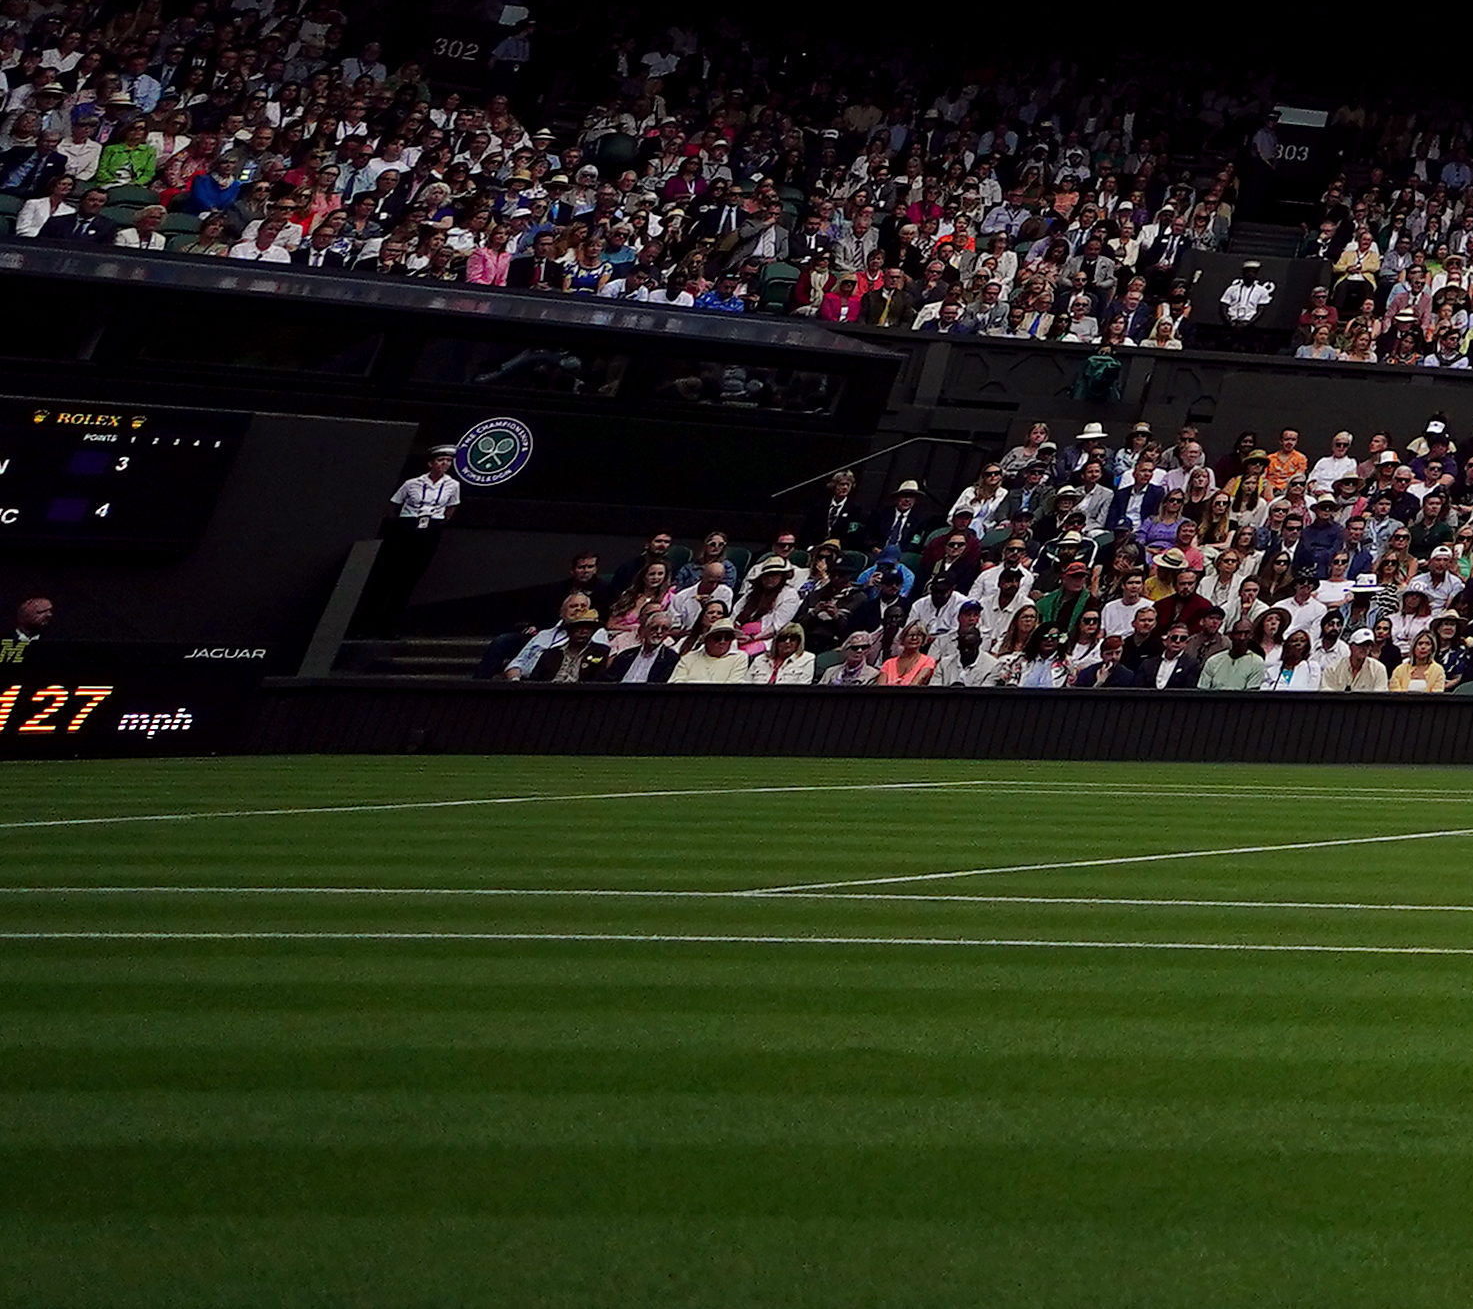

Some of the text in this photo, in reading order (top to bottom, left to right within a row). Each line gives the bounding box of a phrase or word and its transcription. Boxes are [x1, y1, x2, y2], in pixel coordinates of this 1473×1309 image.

[433, 38, 479, 61] 302
[1275, 144, 1309, 161] 303
[56, 412, 122, 428] ROLEX
[461, 420, 529, 452] THE CHAMPIONSHIPS
[115, 456, 130, 472] 3
[95, 502, 110, 517] 4
[184, 648, 267, 659] JAGUAR
[0, 685, 193, 739] 127 mph
